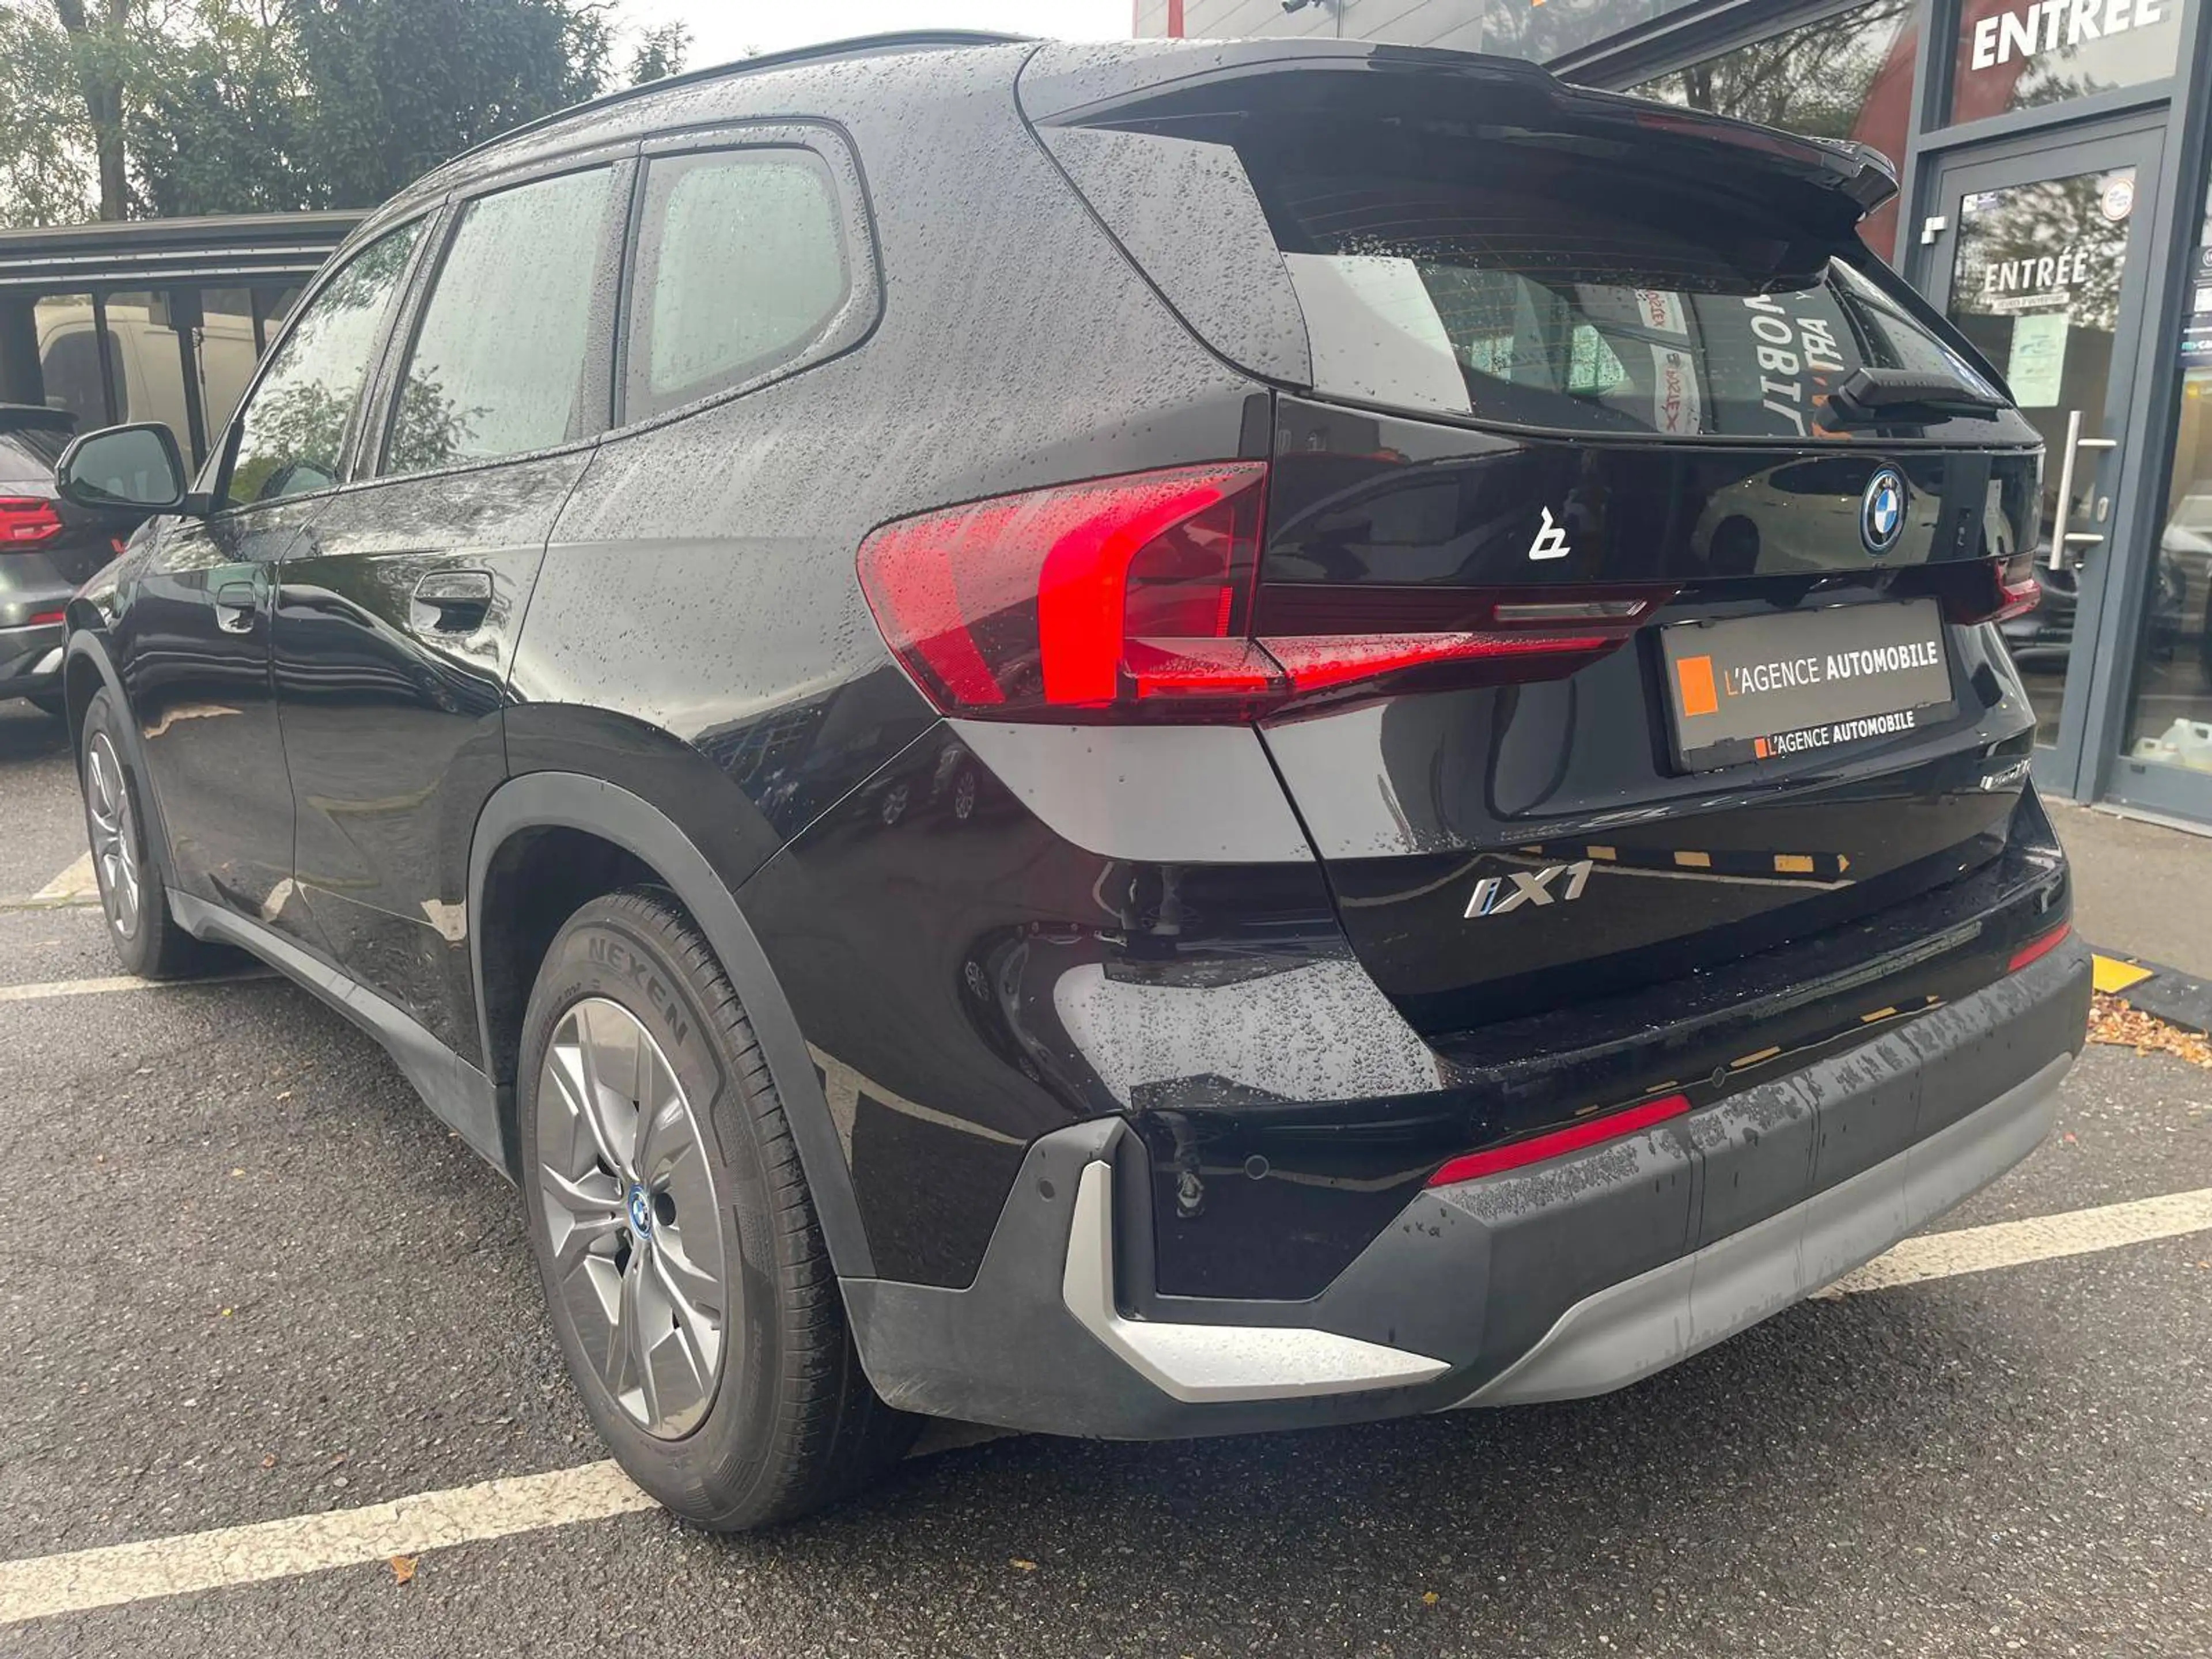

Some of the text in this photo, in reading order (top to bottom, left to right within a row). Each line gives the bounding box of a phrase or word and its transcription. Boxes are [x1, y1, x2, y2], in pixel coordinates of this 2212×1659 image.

[1984, 246, 2088, 292] ENTRÉE
[1724, 641, 1938, 696] L'AGENCE AUTOMOBILE
[1766, 711, 1915, 756] L'AGENCE AUTOMOBILE
[588, 938, 688, 1047] NEXEN
